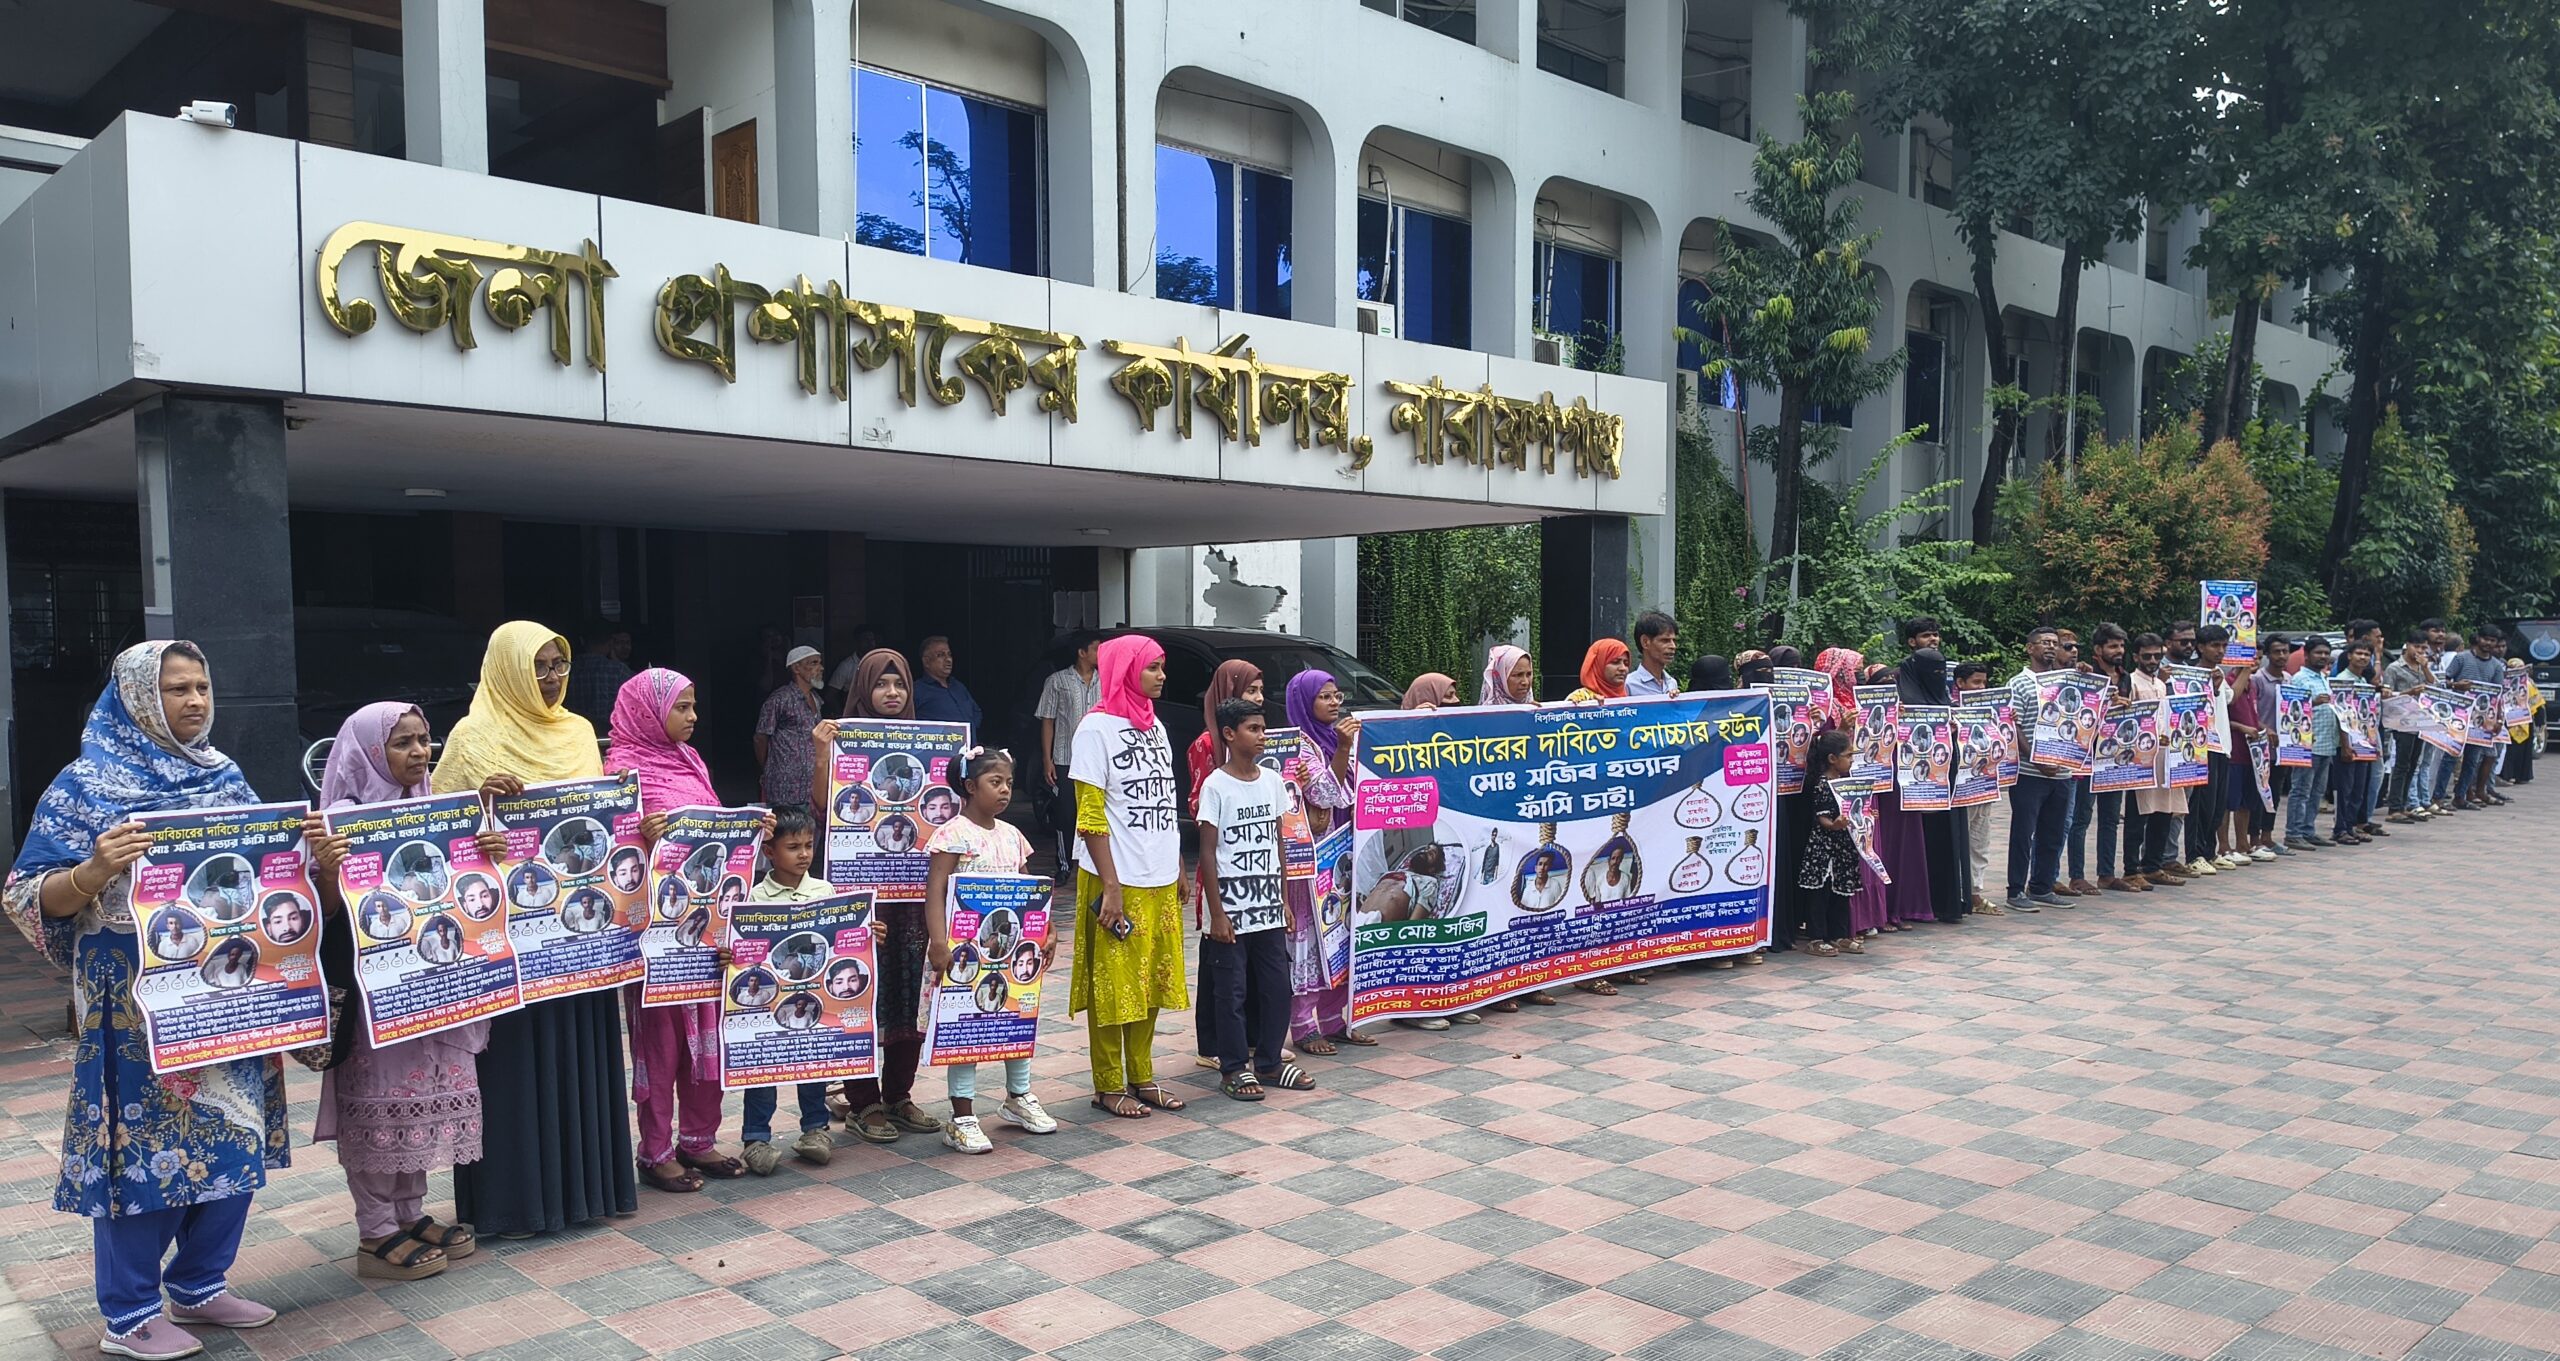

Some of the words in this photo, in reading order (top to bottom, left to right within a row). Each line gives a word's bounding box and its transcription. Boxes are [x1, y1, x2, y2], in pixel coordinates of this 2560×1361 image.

[315, 220, 619, 373] জেলা
[652, 262, 1087, 424] প্রশাসকের
[1384, 375, 1624, 480] নারায়ণগঞ্জ
[1371, 732, 1531, 773] ন্যায়বিচারের
[1536, 722, 1621, 758] দাবিতে
[1630, 720, 1710, 750] সোচ্চার
[1713, 711, 1764, 743] হউন
[1360, 782, 1400, 794] অতর্কিত
[1402, 782, 1434, 792] হামলার
[1469, 771, 1516, 798] মোঃ
[1526, 759, 1598, 786] সজিব
[1606, 754, 1681, 778] হত্যার
[1364, 794, 1408, 804] প্রতিবাদে
[1410, 791, 1430, 802] তীব্র
[1364, 804, 1390, 815] নিন্দা
[1392, 802, 1428, 814] জানাচ্ছি
[1516, 791, 1574, 820] ফাঁসি
[1237, 804, 1270, 820] ROLEX
[1230, 849, 1271, 872] বাবা
[1398, 924, 1436, 941] মোঃ
[1444, 916, 1486, 937] সজিব
[1412, 983, 1470, 996] নাগরিক
[1473, 972, 1504, 986] সমাজ
[1520, 960, 1552, 974] নিহত
